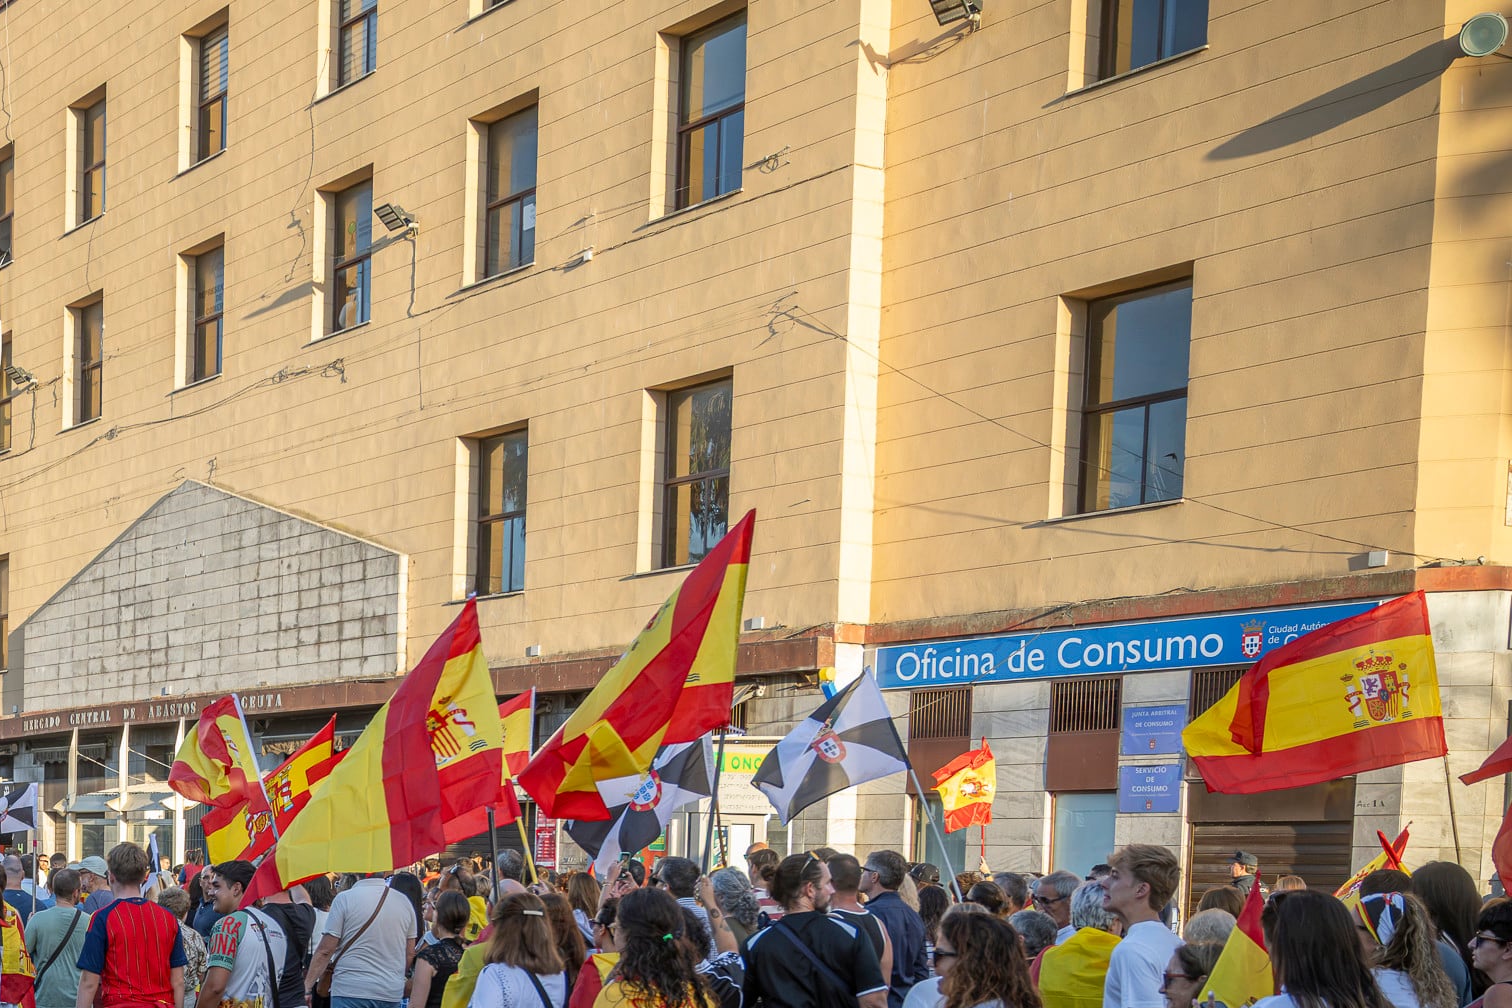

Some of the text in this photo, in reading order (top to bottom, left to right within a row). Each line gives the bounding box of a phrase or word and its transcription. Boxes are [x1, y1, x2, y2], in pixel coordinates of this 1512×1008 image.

[1268, 624, 1298, 634] Ciudad
[1268, 635, 1280, 644] de
[896, 633, 1224, 681] Oficina de Consumo
[240, 693, 282, 708] CEUTA
[23, 701, 197, 732] MERCADO CENTRAL DE ABASTOS
[1135, 766, 1167, 774] SERVICIO
[1131, 785, 1168, 793] CONSUMO
